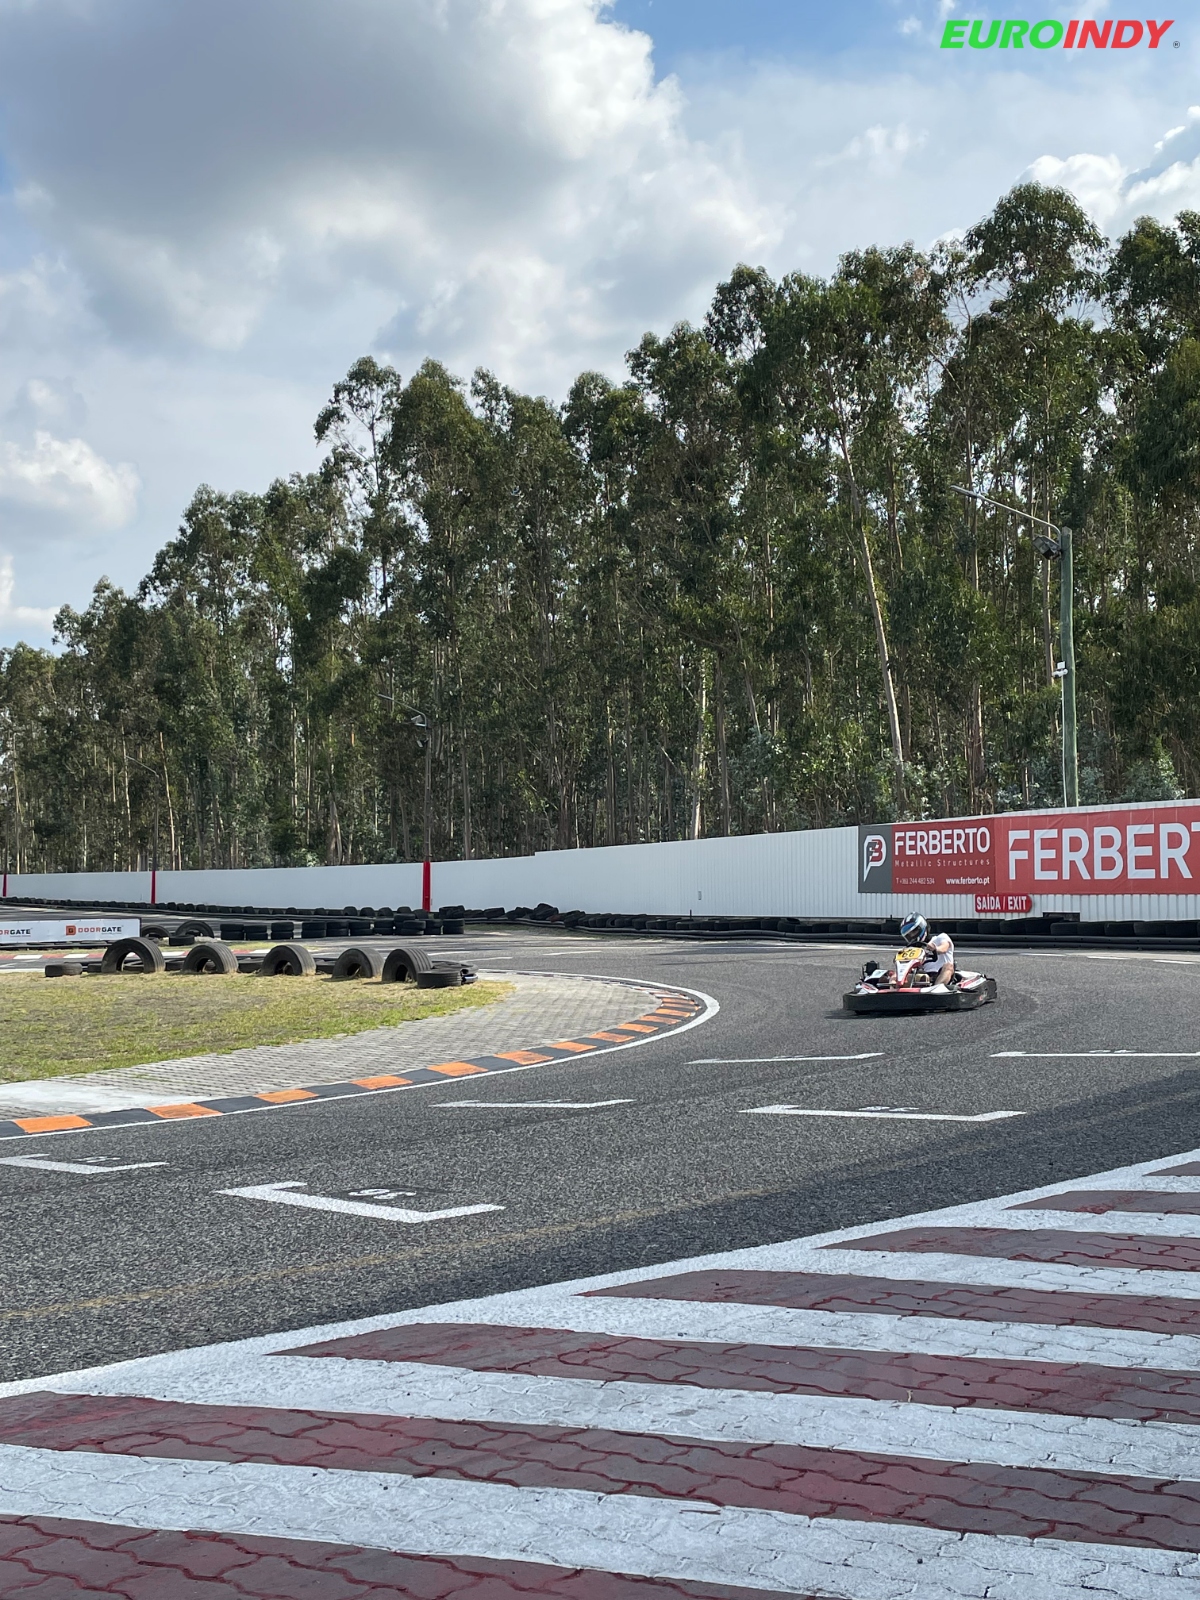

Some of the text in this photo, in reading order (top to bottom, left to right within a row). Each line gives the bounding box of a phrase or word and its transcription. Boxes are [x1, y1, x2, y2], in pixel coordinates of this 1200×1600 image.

[894, 827, 991, 856] FERBERTO
[894, 858, 990, 868] Metallic Structures
[945, 876, 990, 886] www.ferberto.pt
[976, 894, 1001, 911] SAÍDA
[1007, 895, 1027, 911] EXIT
[78, 926, 122, 934] DOORGATE
